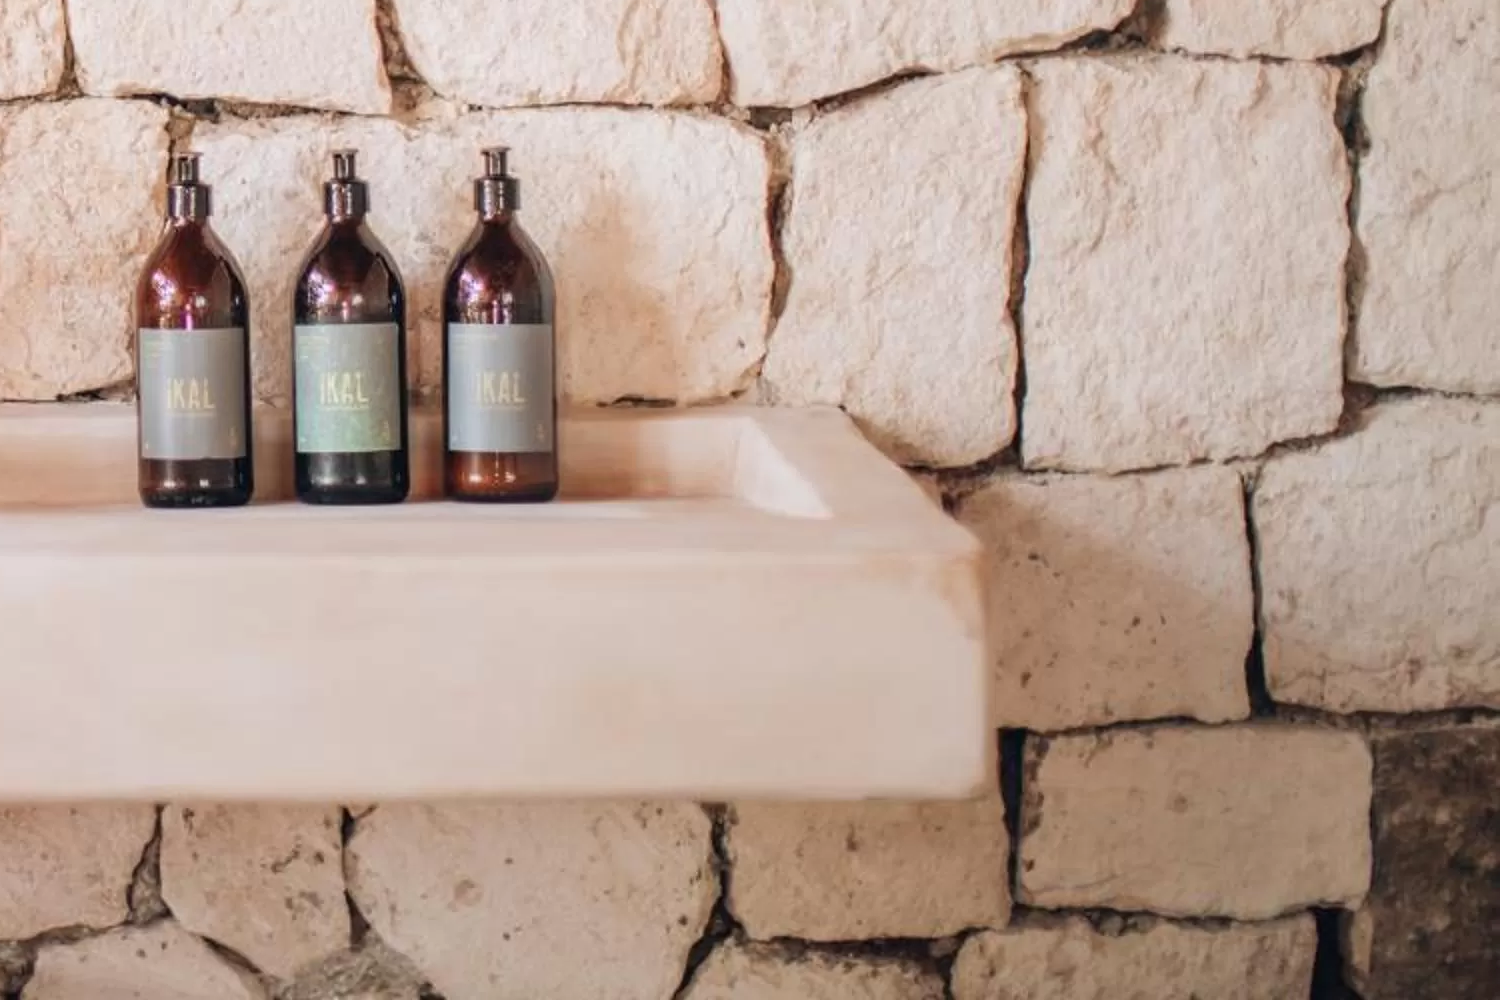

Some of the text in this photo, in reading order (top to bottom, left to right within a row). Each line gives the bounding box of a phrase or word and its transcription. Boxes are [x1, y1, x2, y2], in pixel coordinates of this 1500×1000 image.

[167, 377, 215, 409] IKAL
[320, 371, 369, 404] IKAL
[475, 371, 525, 403] IKAL
